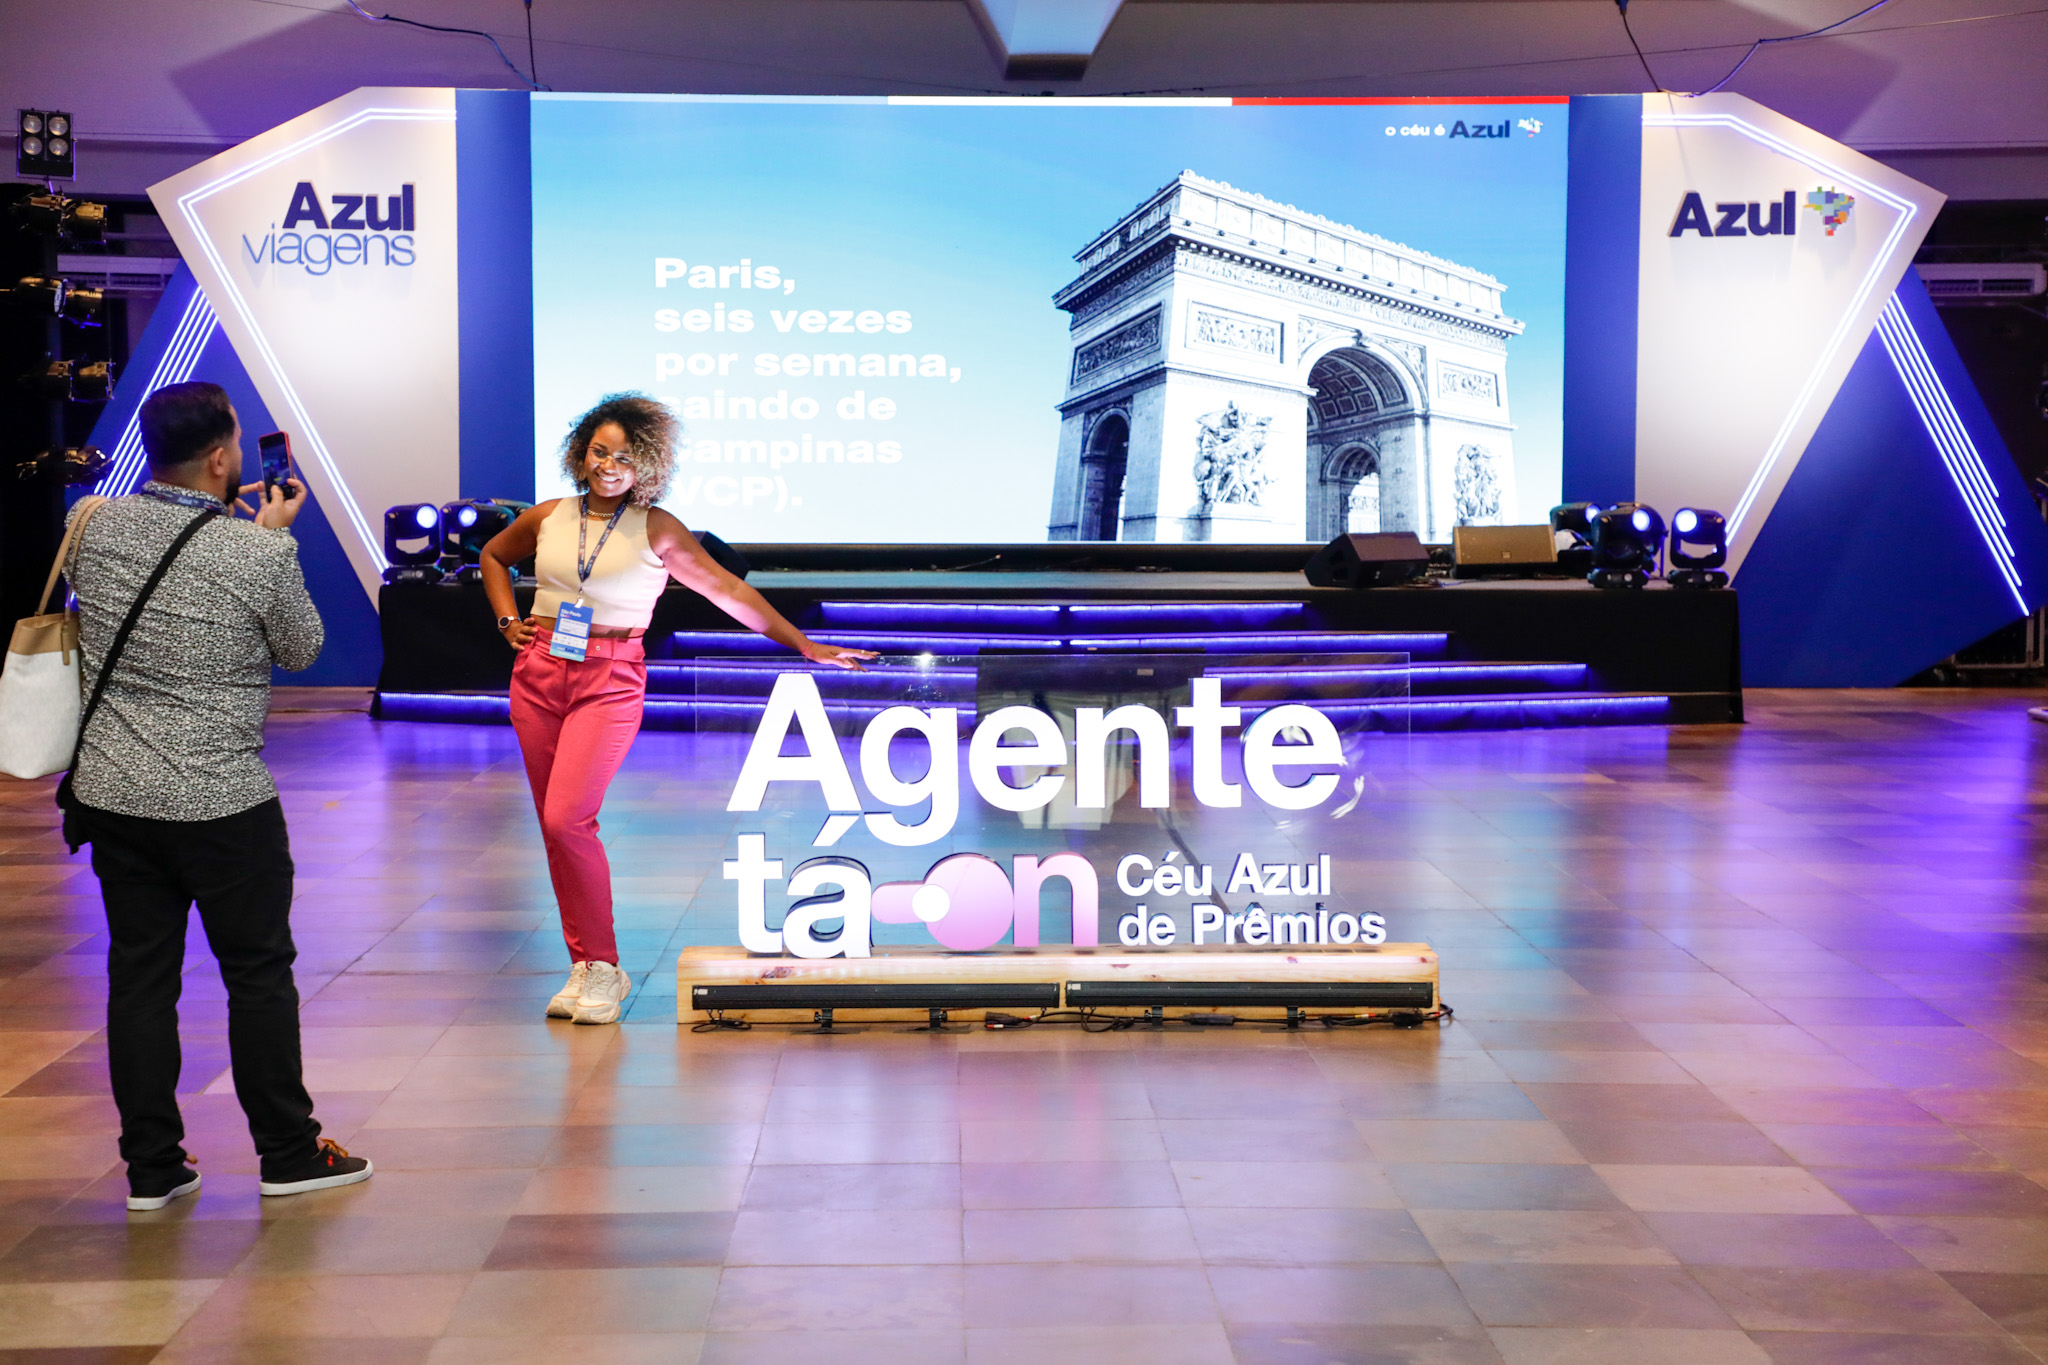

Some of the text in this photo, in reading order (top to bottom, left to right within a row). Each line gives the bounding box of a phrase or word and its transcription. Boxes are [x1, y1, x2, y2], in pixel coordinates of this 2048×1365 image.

[1385, 126, 1396, 136] o
[1400, 124, 1430, 136] céu
[1449, 120, 1511, 138] Azul
[282, 181, 415, 231] Azul
[1669, 190, 1796, 237] Azul
[242, 222, 416, 276] viagens
[655, 257, 795, 295] Paris,
[654, 302, 913, 334] seis vezes
[656, 351, 962, 383] por semana,
[835, 390, 898, 420] de
[726, 672, 1346, 846] Agente
[1116, 851, 1331, 896] Céu Azul
[1118, 902, 1387, 946] de Prêmios
